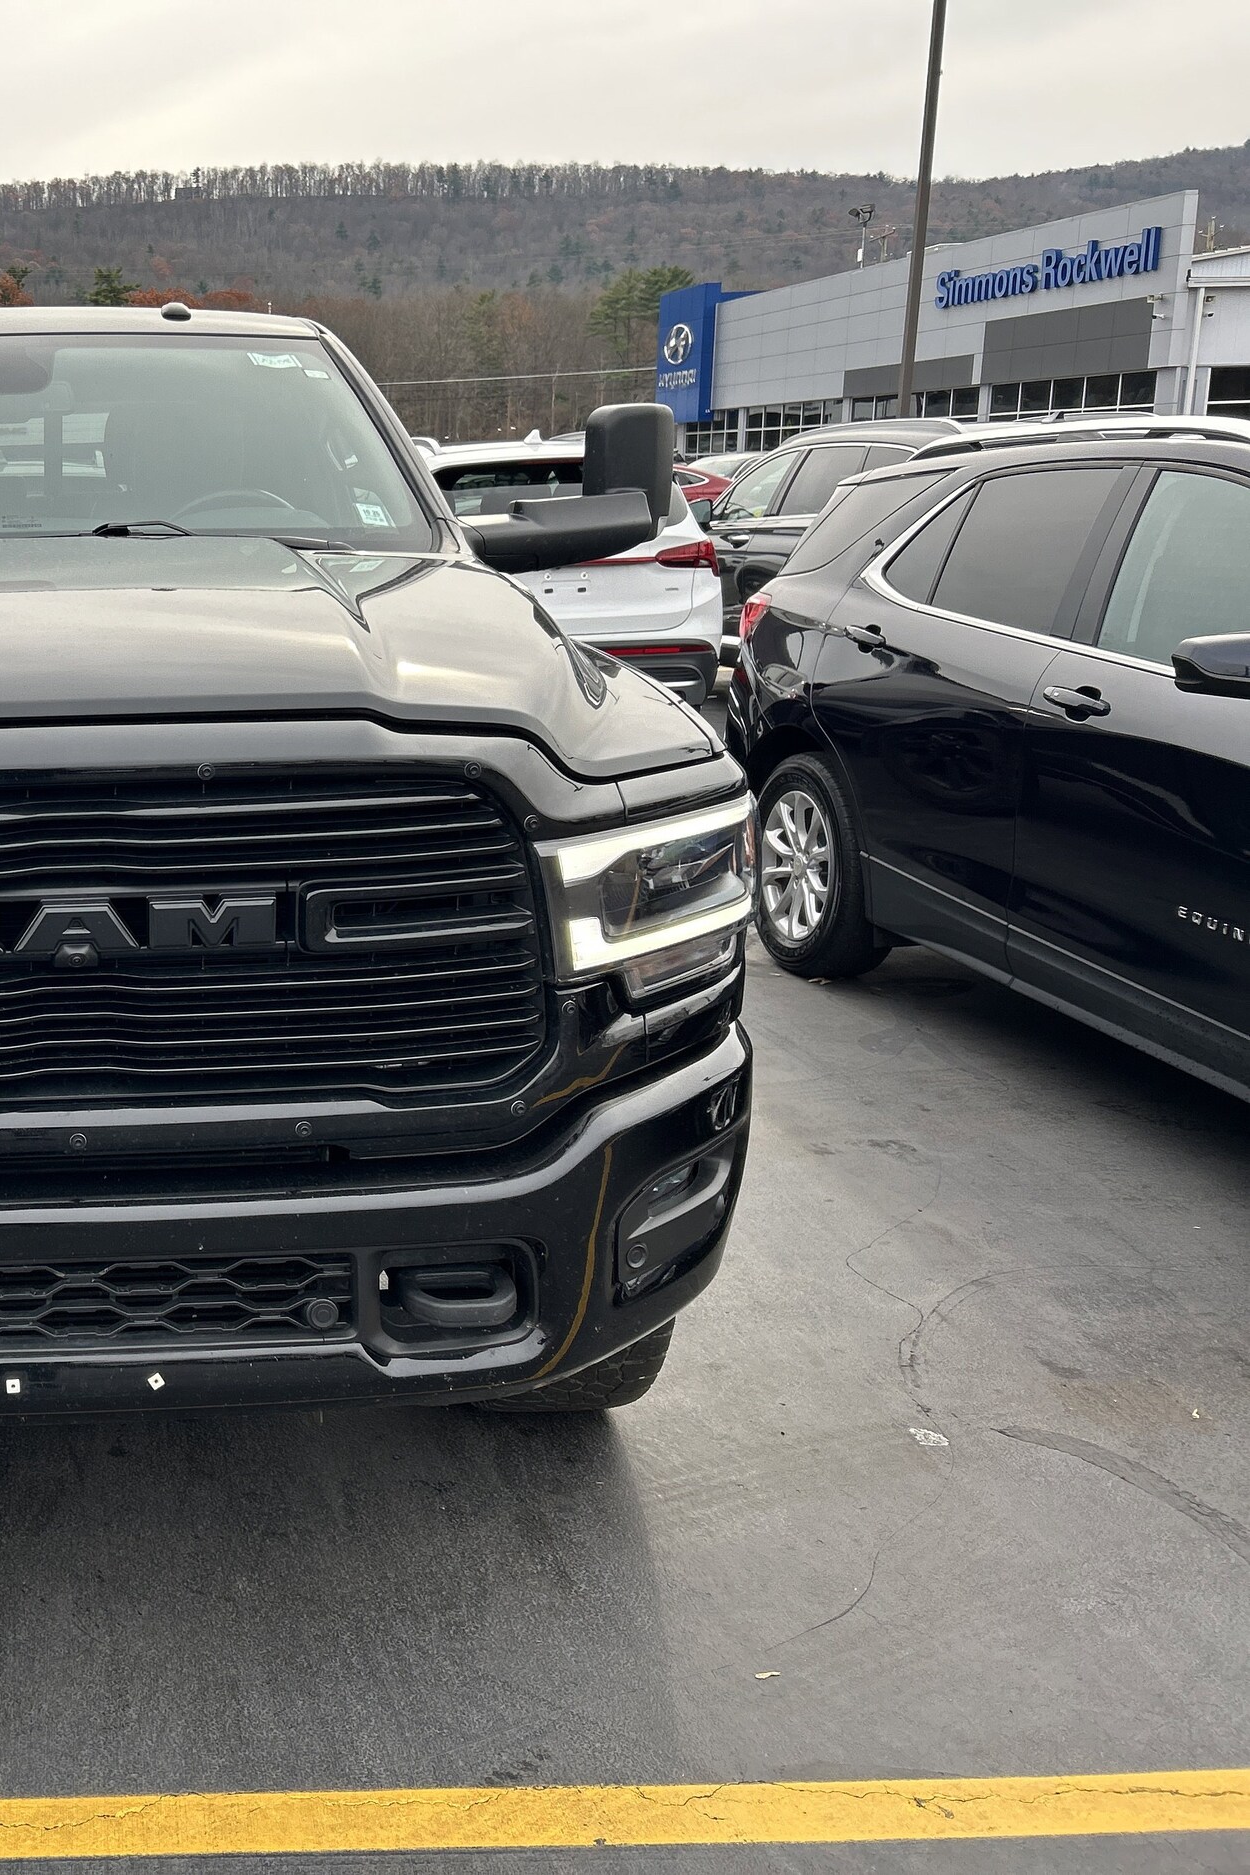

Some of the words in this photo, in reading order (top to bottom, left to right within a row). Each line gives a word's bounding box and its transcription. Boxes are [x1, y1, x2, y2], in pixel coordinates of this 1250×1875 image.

[935, 263, 1038, 310] Simmons
[1040, 226, 1162, 291] Rockwell
[1177, 905, 1250, 945] EQUIN
